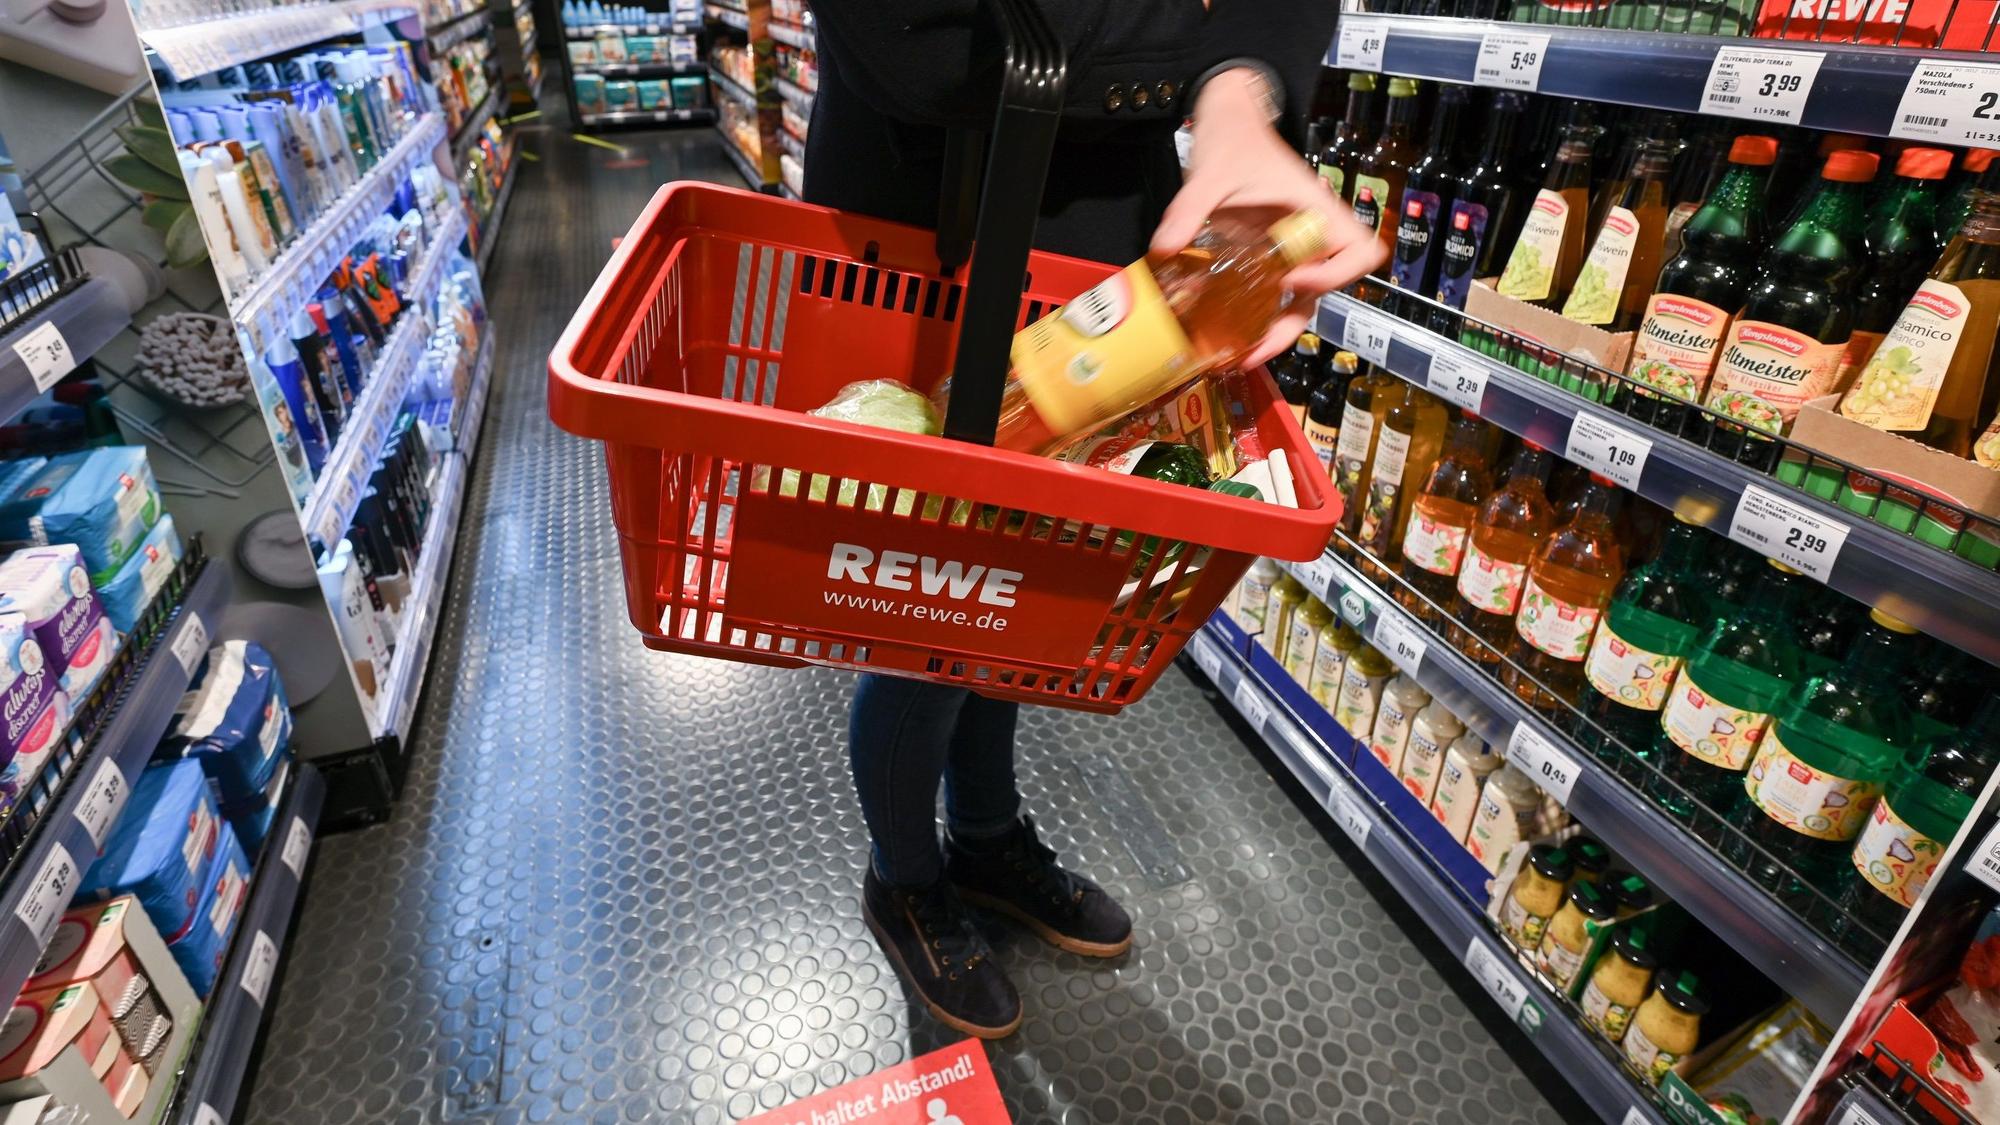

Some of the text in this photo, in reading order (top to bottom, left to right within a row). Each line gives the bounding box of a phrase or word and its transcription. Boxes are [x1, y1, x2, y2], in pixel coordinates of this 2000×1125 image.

[1511, 52, 1536, 70] 5.49
[1759, 73, 1801, 97] 3.99
[1914, 87, 1937, 95] 750ml
[1919, 79, 1966, 89] Verschiedene
[1641, 317, 1720, 349] Altmeister
[1721, 345, 1811, 381] Altmeister
[1456, 376, 1478, 393] 2.39
[1310, 430, 1336, 444] THO
[1608, 446, 1636, 466] 1.09
[1745, 500, 1787, 522] HENGSTENBERG
[1765, 501, 1797, 519] BALSAMICO
[1798, 517, 1821, 529] BIANCO
[1785, 527, 1827, 553] 2.99
[827, 542, 1024, 608] REWE
[58, 592, 94, 638] always
[823, 590, 1008, 631] www.rewe.de
[4, 667, 46, 721] always
[7, 691, 41, 741] discreet
[1541, 760, 1567, 785] 0.45
[51, 861, 70, 897] 3.29
[882, 1054, 976, 1109] Abstand!
[1668, 1082, 1715, 1125] Dev
